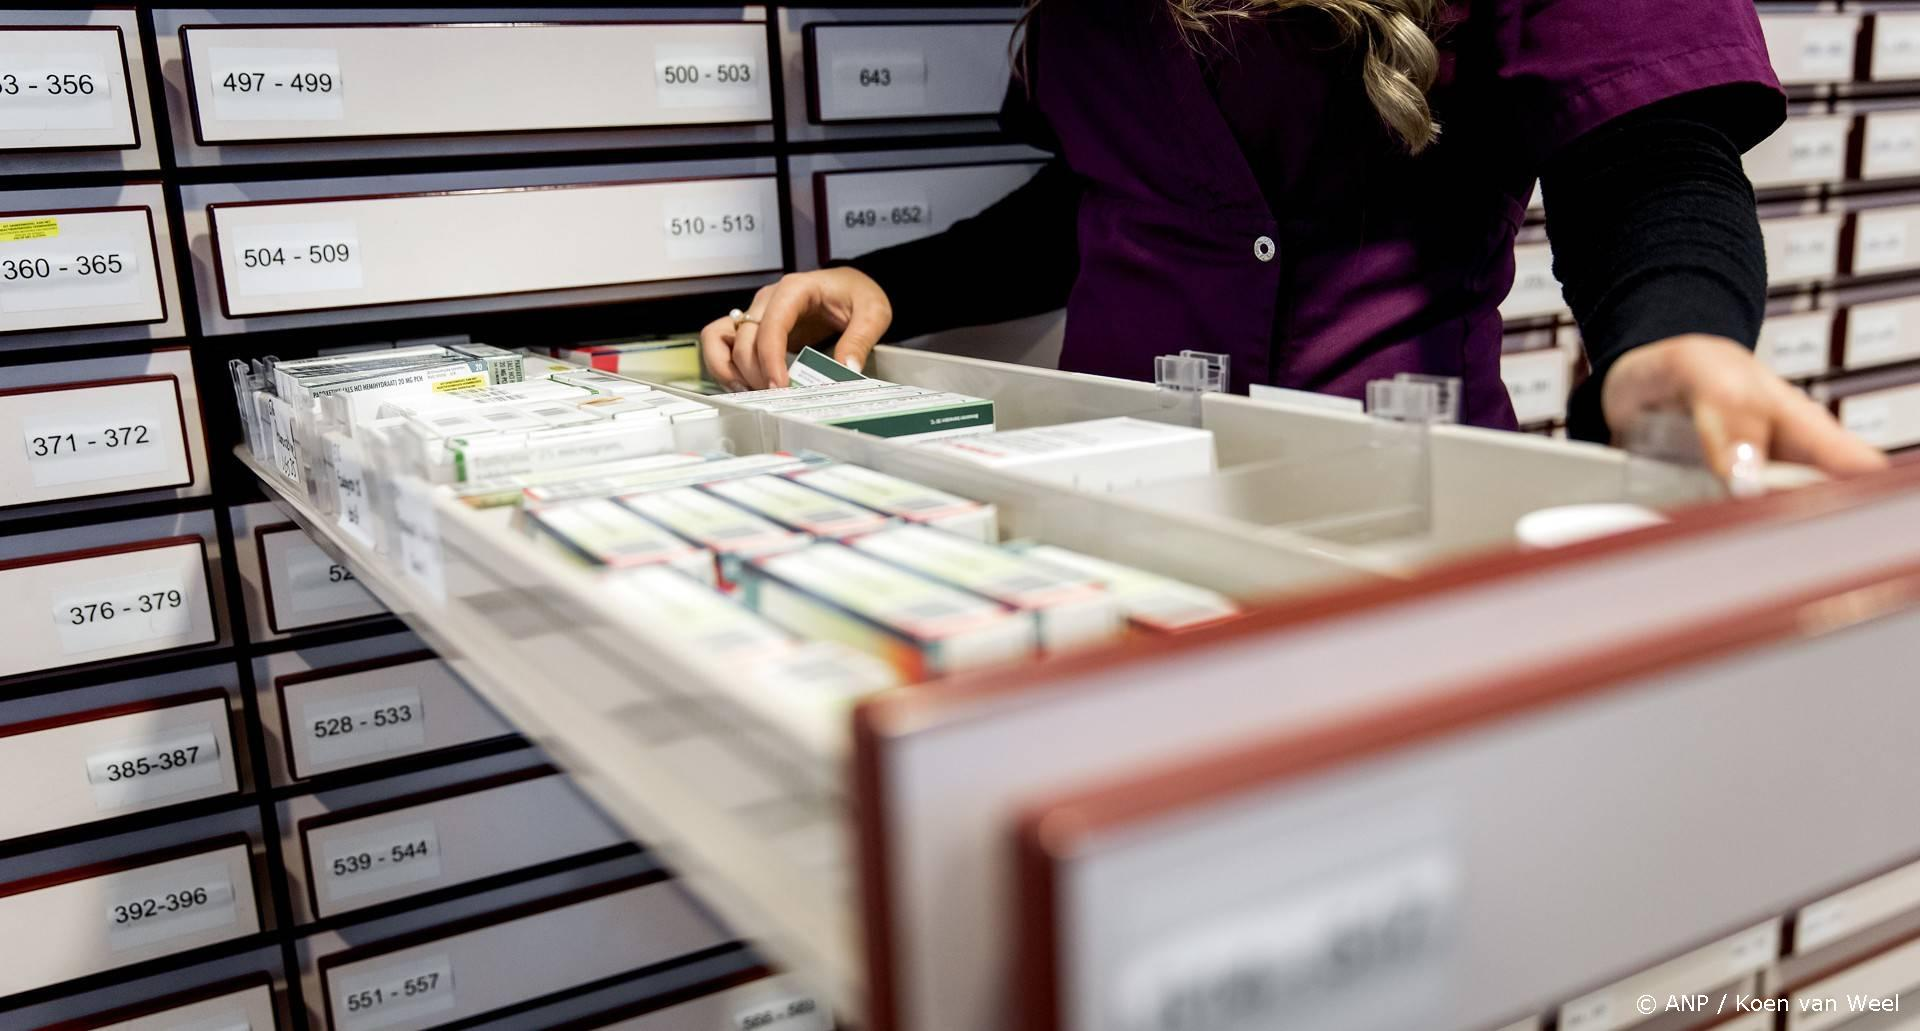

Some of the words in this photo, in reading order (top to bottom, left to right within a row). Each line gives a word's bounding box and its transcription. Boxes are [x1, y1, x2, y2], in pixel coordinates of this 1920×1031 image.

[0, 75, 19, 94] 3
[47, 75, 93, 94] 356
[224, 73, 264, 92] 497
[291, 74, 331, 92] 499
[665, 66, 698, 83] 500
[718, 65, 750, 82] 503
[860, 69, 891, 86] 643
[672, 219, 704, 234] 510
[723, 215, 755, 231] 513
[846, 211, 876, 228] 649
[892, 207, 922, 224] 652
[3, 259, 49, 280] 360
[77, 255, 122, 275] 365
[245, 248, 285, 267] 504
[310, 244, 348, 263] 509
[33, 434, 76, 456] 371
[105, 426, 149, 447] 372
[70, 602, 114, 624] 376
[139, 590, 181, 612] 379
[315, 717, 353, 737] 528
[374, 706, 411, 726] 533
[108, 746, 199, 781] 385-387
[334, 854, 371, 875] 539
[392, 841, 427, 862] 544
[116, 888, 207, 923] 392-396
[348, 989, 382, 1011] 551
[405, 973, 438, 996] 557
